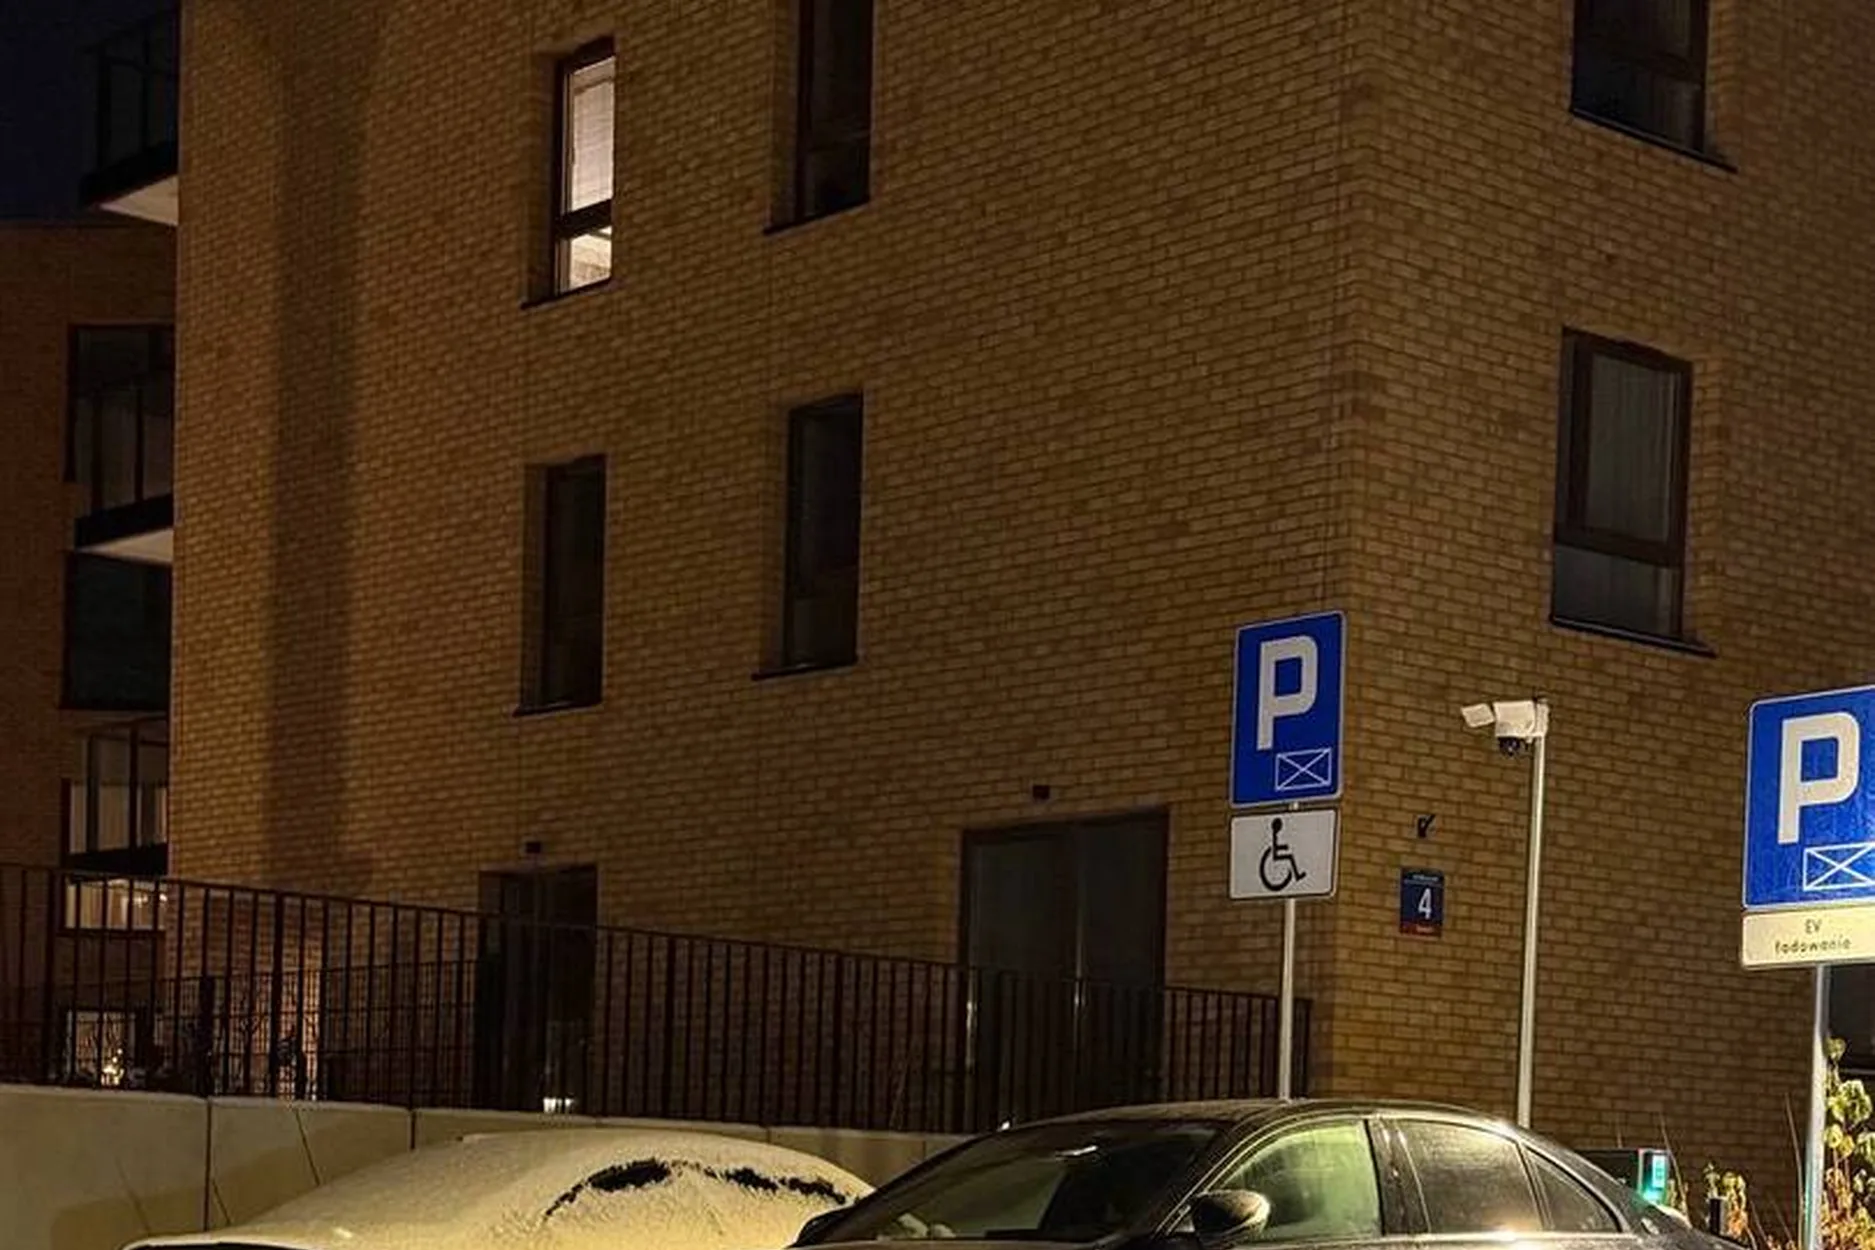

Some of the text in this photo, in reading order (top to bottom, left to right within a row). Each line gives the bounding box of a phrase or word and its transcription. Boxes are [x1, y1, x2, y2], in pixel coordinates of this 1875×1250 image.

[1257, 635, 1318, 751] P
[1778, 712, 1860, 845] P
[1418, 888, 1432, 919] 4
[1804, 918, 1822, 934] EV
